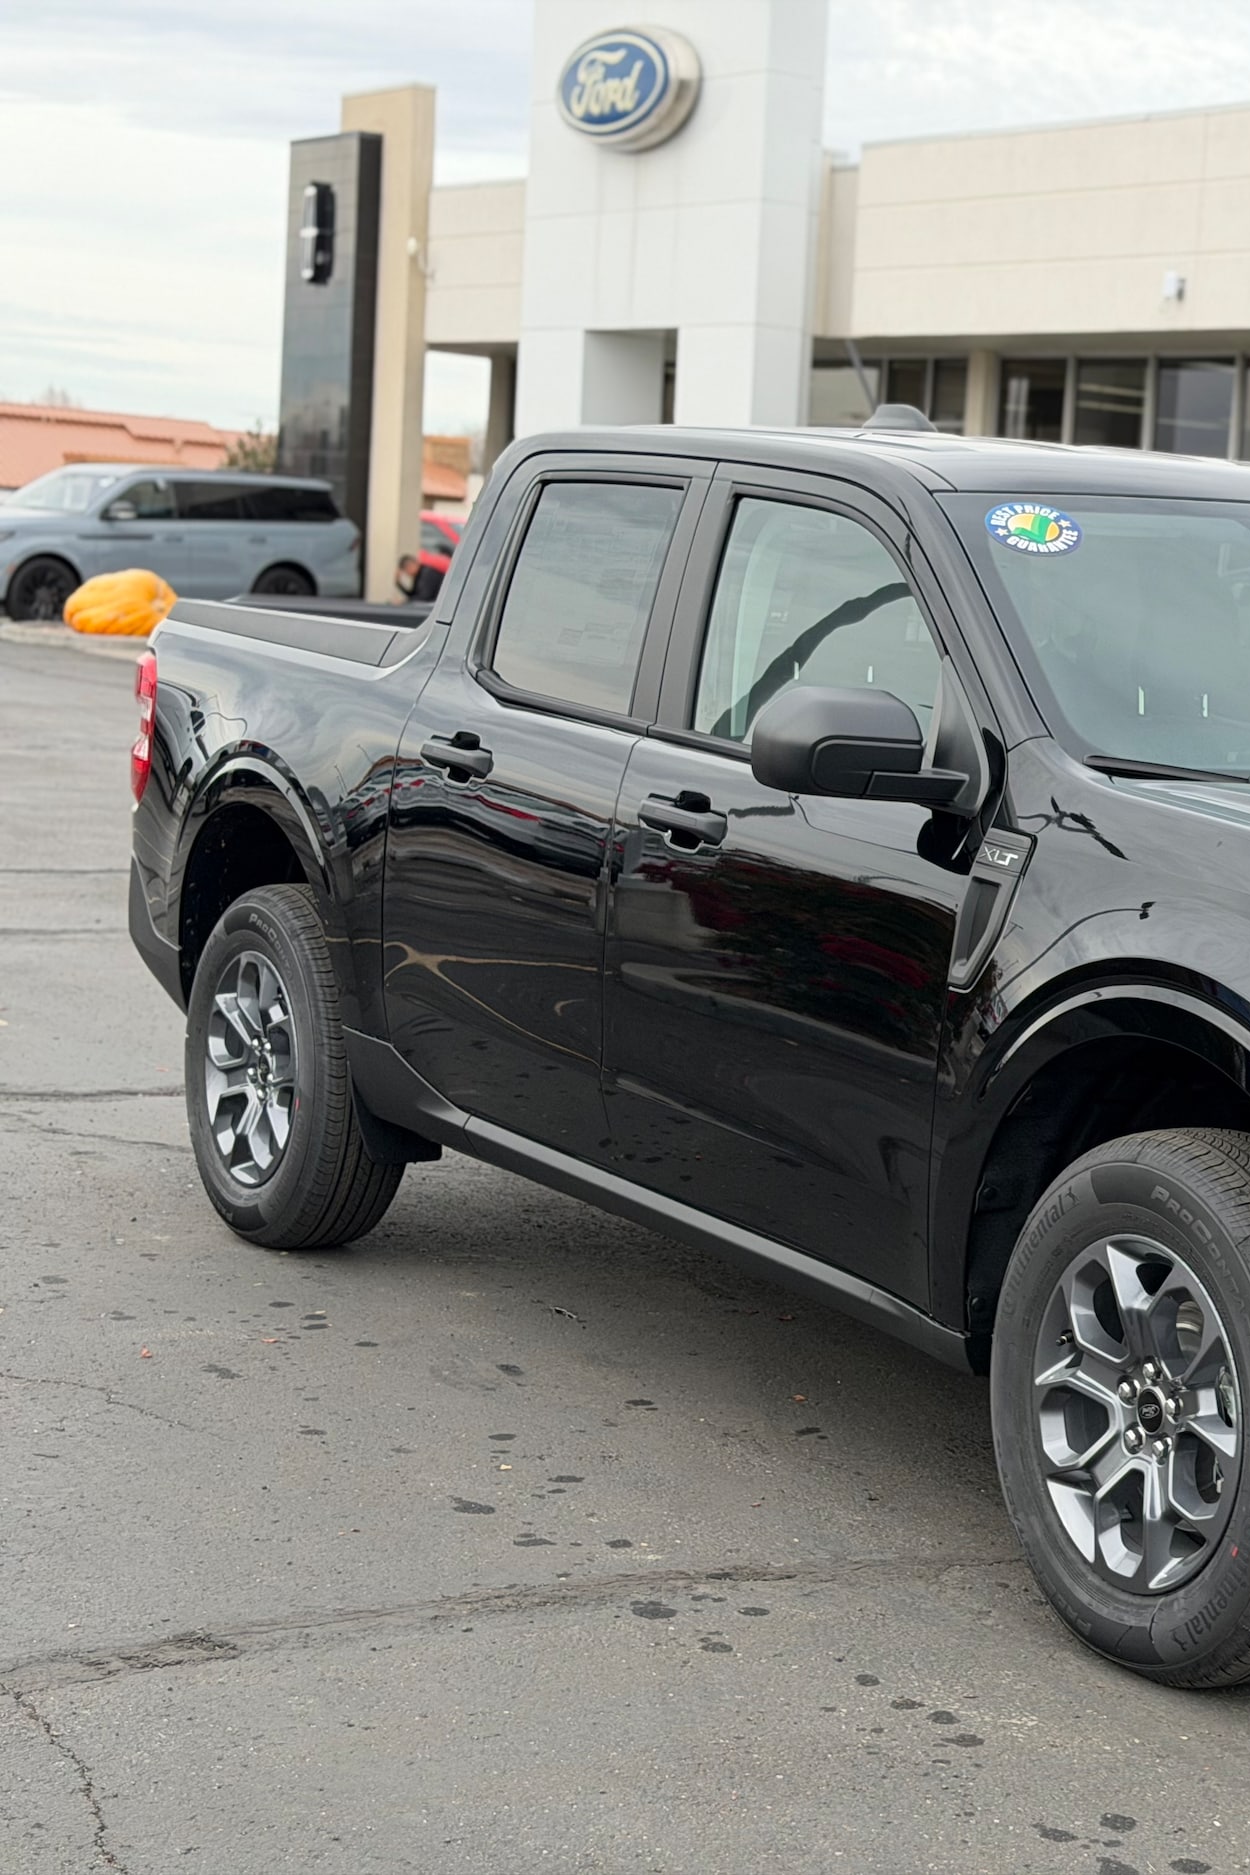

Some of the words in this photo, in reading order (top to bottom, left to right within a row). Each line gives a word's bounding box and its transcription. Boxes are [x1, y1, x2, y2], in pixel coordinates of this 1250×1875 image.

[571, 48, 643, 118] Ford
[990, 506, 1016, 526] BEST
[1013, 504, 1060, 520] PRICE
[1006, 529, 1078, 553] GUARANTEE
[979, 846, 1019, 867] XLT
